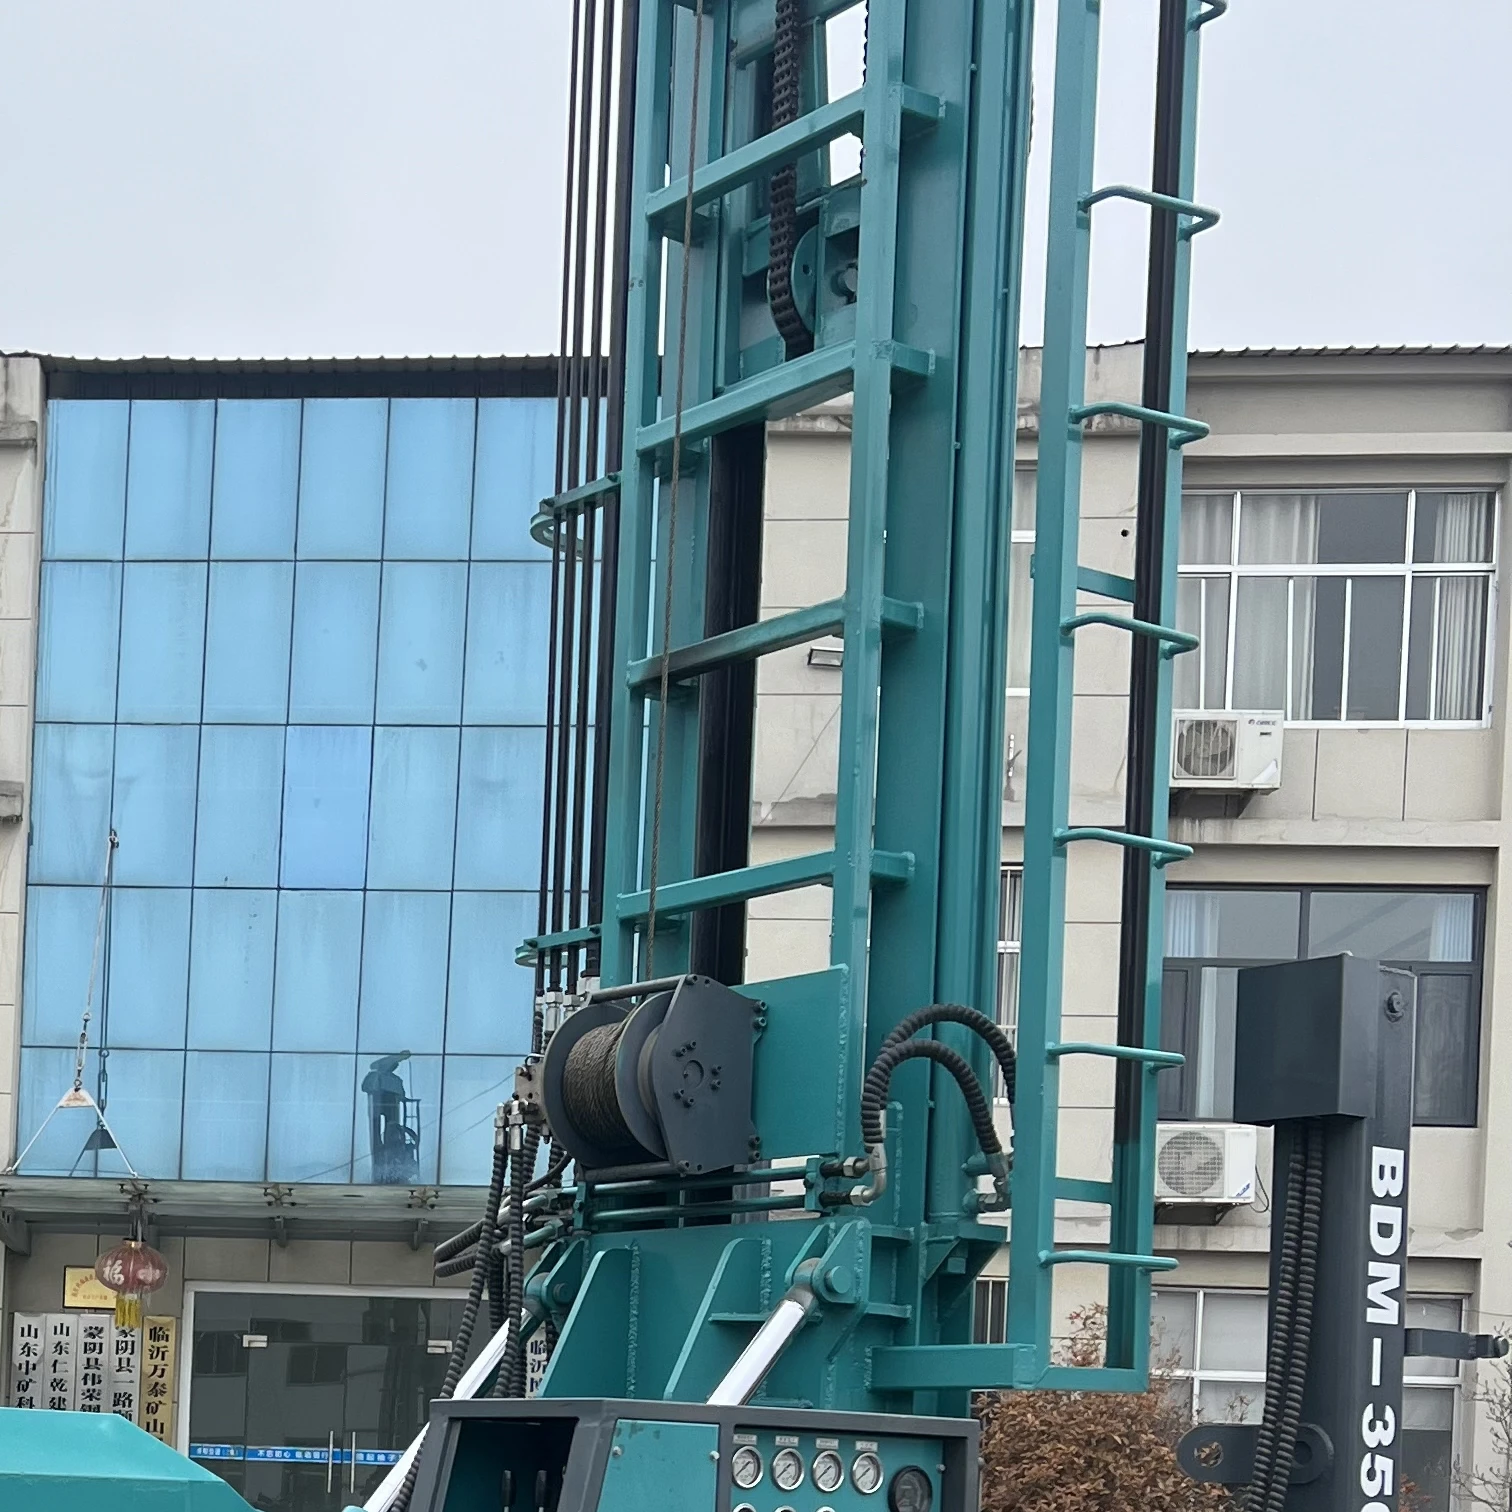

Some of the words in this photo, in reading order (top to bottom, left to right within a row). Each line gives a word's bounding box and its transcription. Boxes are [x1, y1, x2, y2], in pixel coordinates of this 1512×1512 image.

[145, 1326, 170, 1441] 临沂万泰矿山
